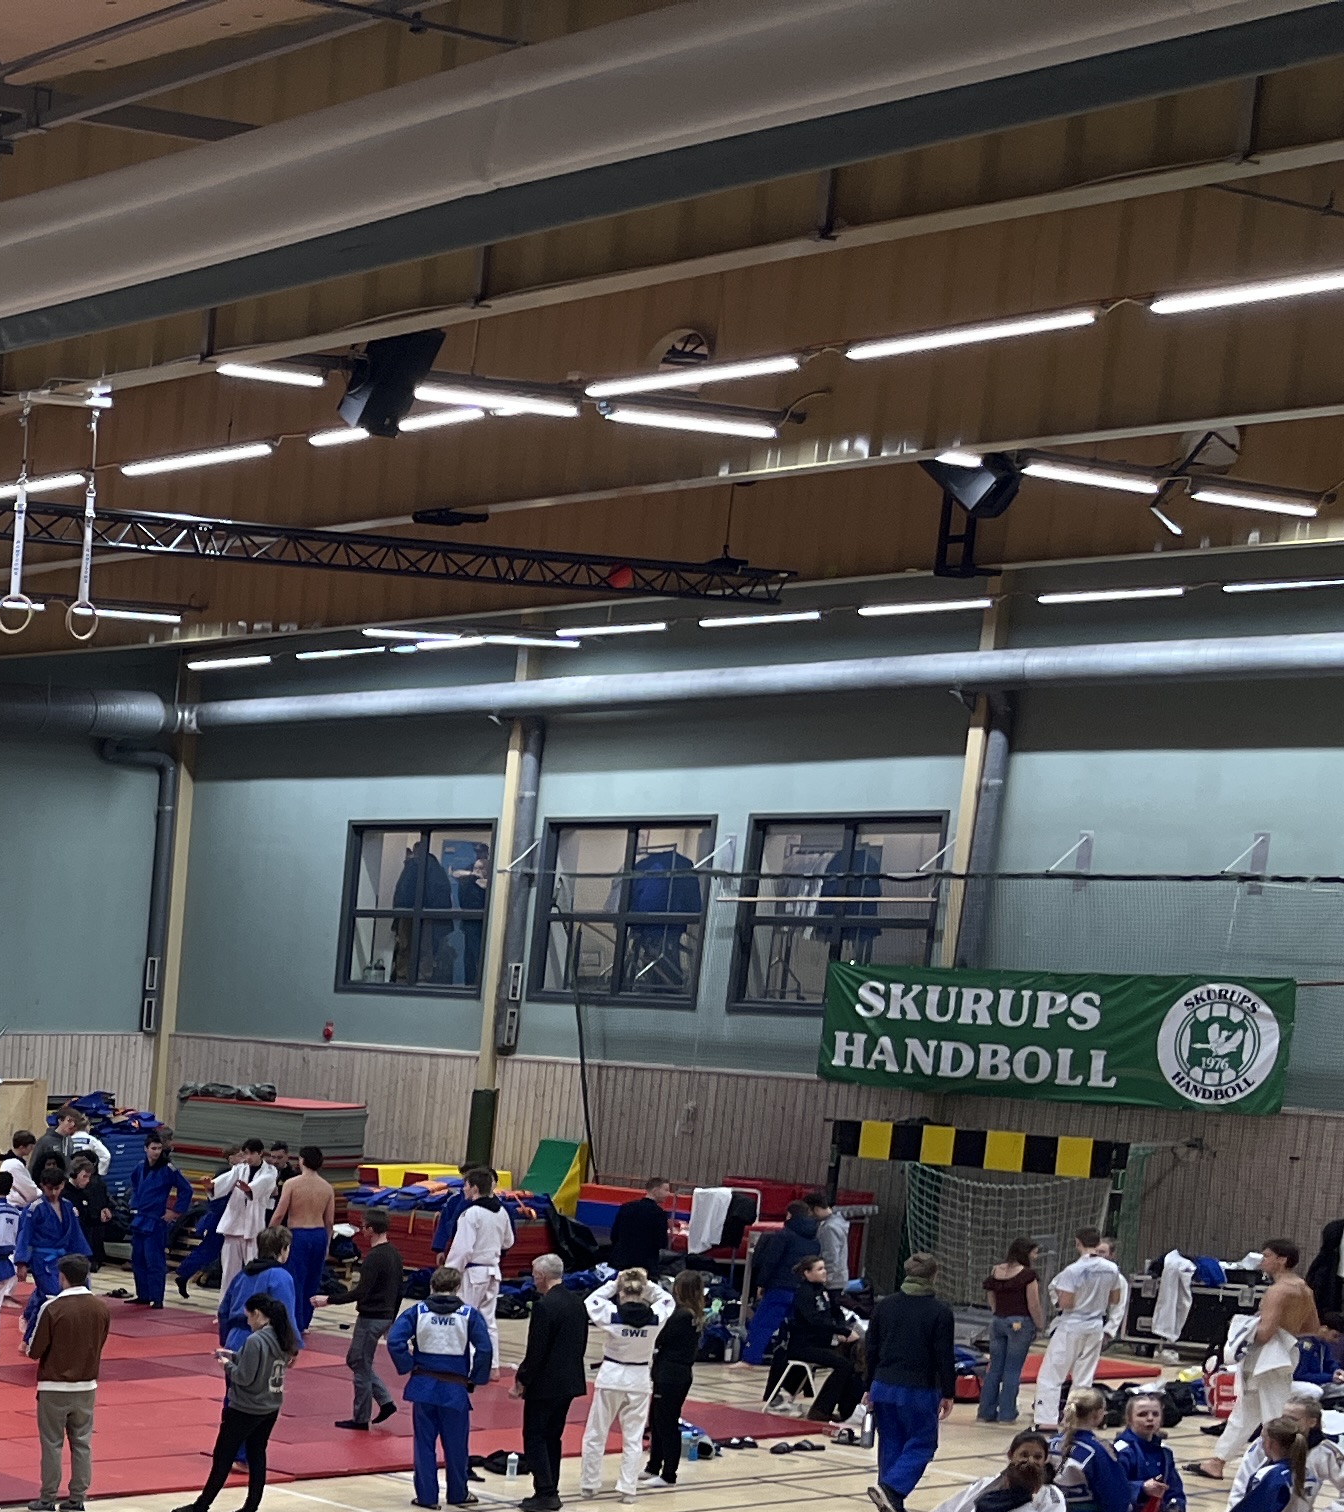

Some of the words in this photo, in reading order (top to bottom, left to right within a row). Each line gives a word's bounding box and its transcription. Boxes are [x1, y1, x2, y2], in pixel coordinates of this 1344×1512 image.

[855, 980, 1101, 1031] SKURUPS
[1184, 988, 1260, 1013] SKURUPS
[831, 1031, 1117, 1088] HANDBOLL
[1201, 1056, 1230, 1070] 1976
[1172, 1071, 1255, 1101] HANDBOLL
[431, 1316, 456, 1326] SWE
[621, 1328, 648, 1338] SWE
